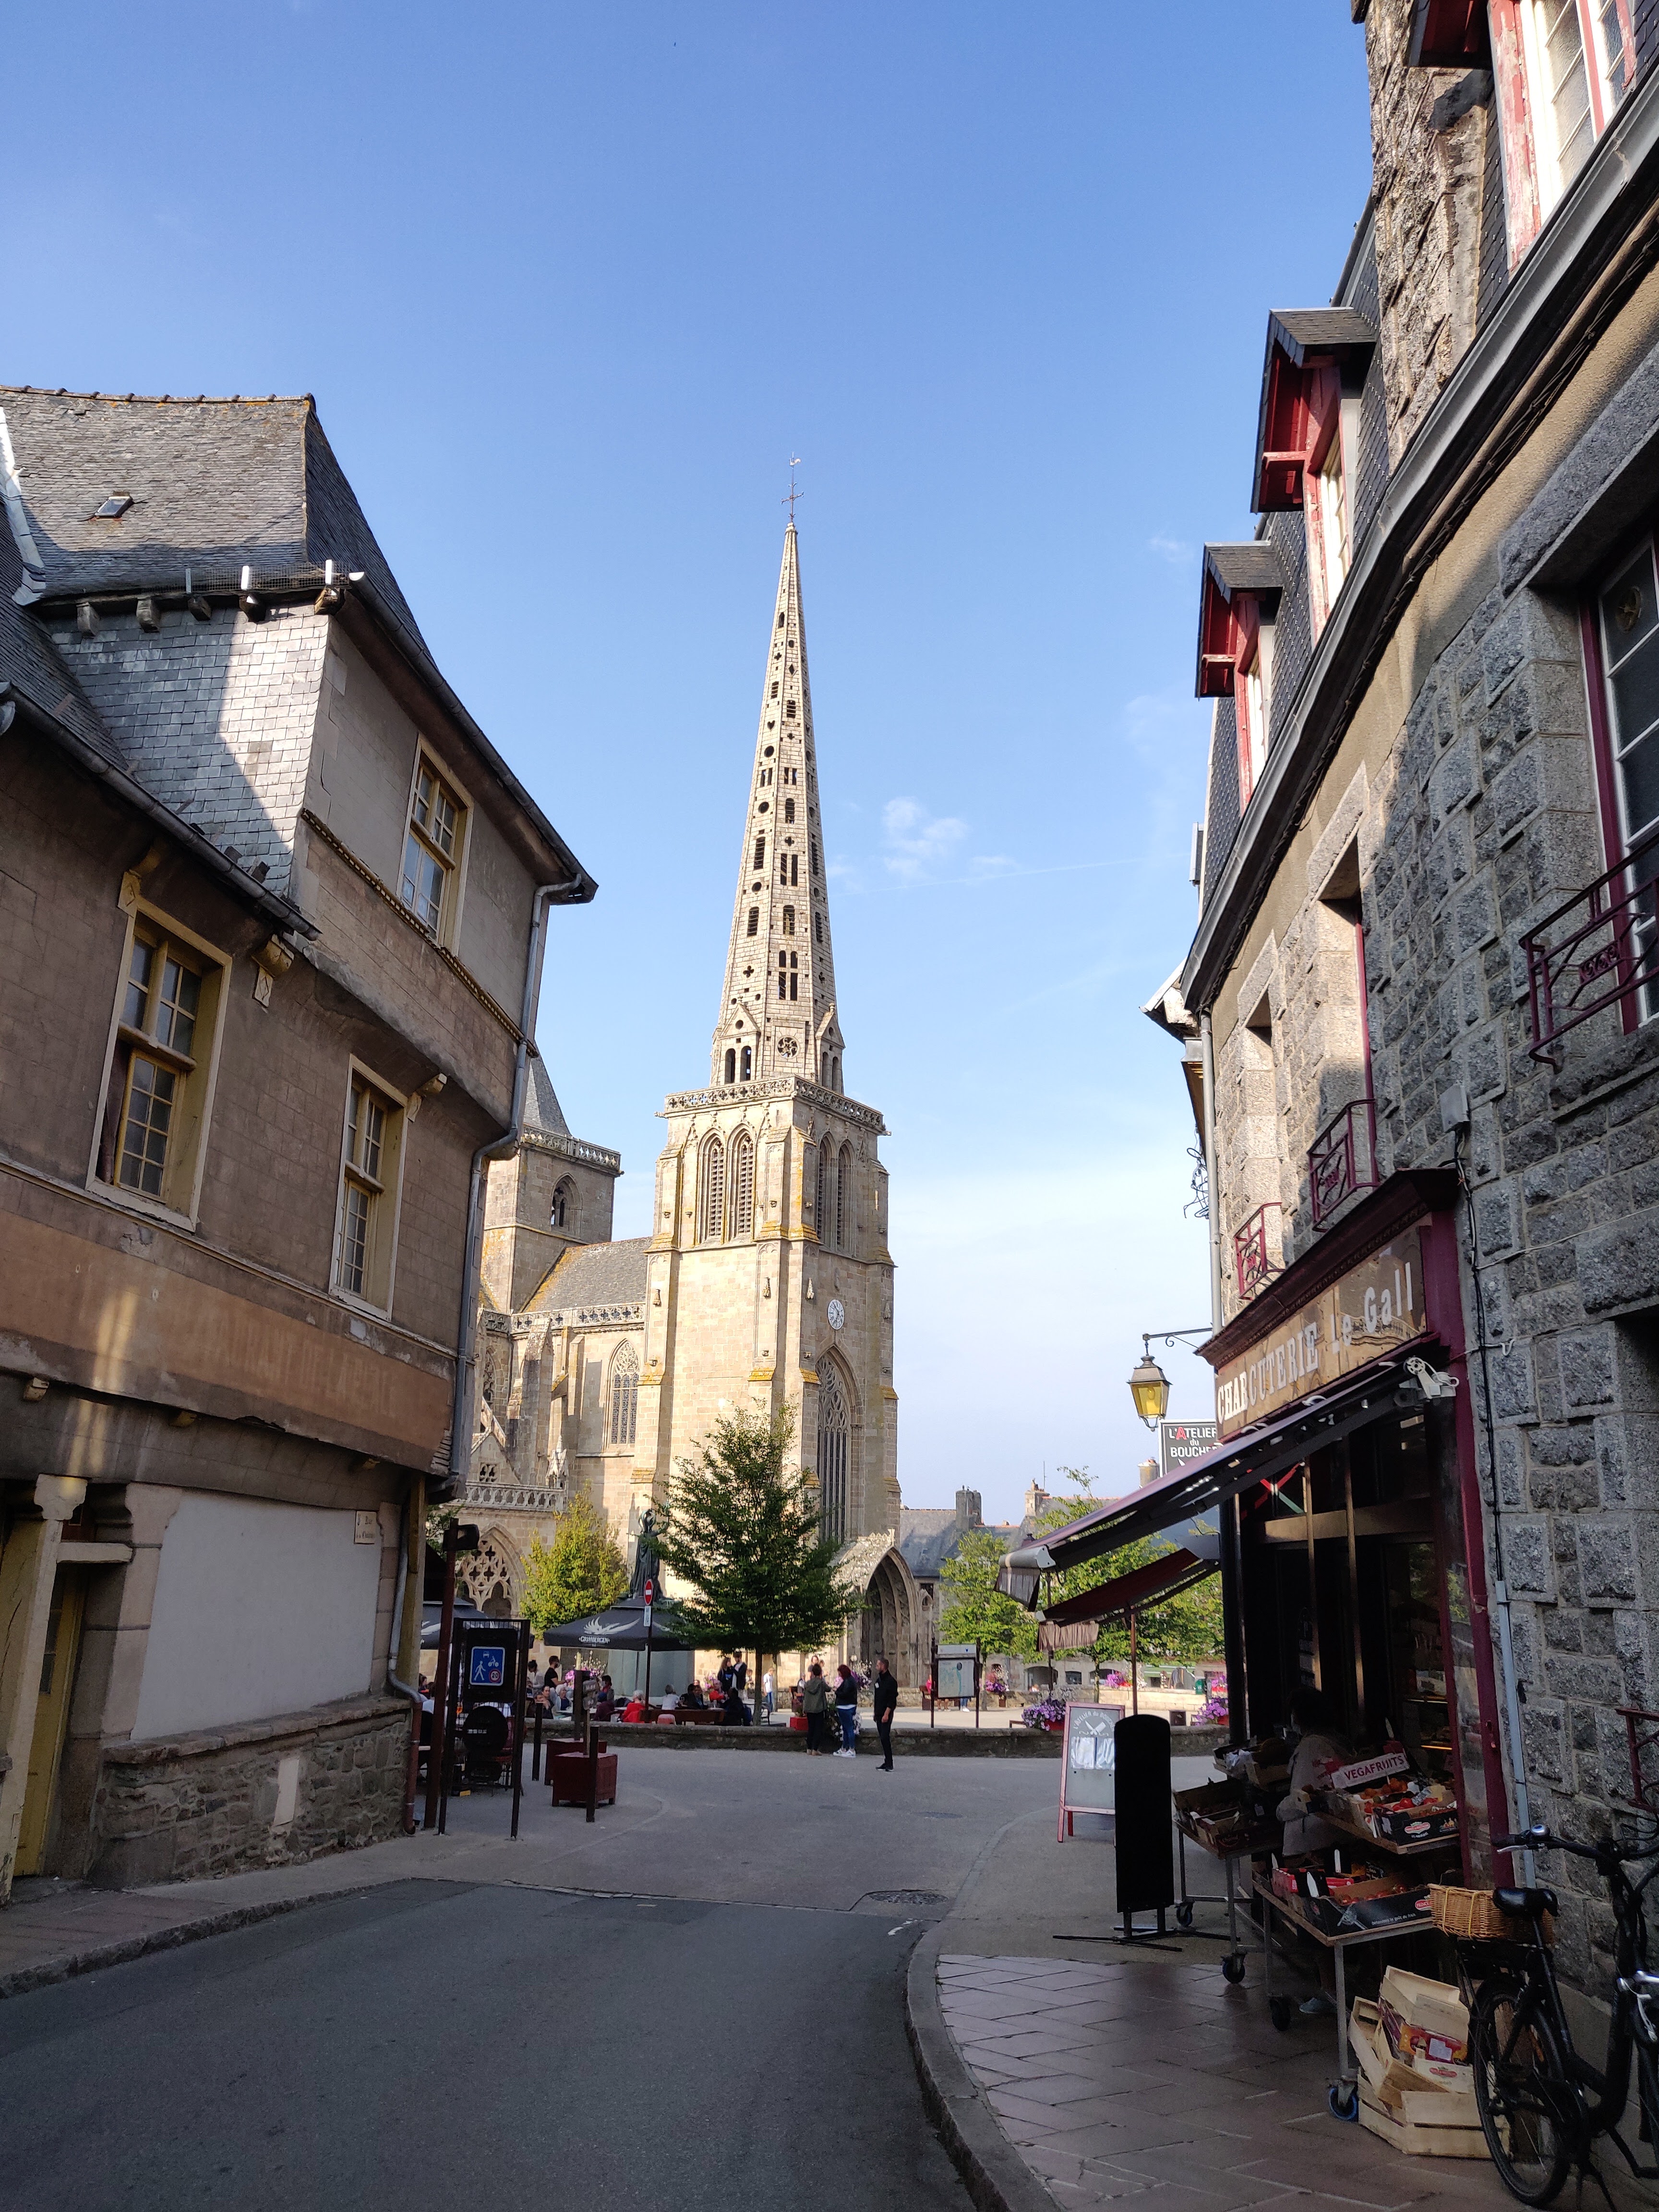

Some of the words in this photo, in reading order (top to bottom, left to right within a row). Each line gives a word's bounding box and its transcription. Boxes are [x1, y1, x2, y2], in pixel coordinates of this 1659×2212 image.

[1217, 1322, 1319, 1424] CHARCUTERIE
[1330, 1314, 1352, 1354] Le
[1364, 1262, 1413, 1333] Gall
[1170, 1446, 1217, 1457] BOUCH
[1344, 1755, 1405, 1780] VEGAFRUITS
